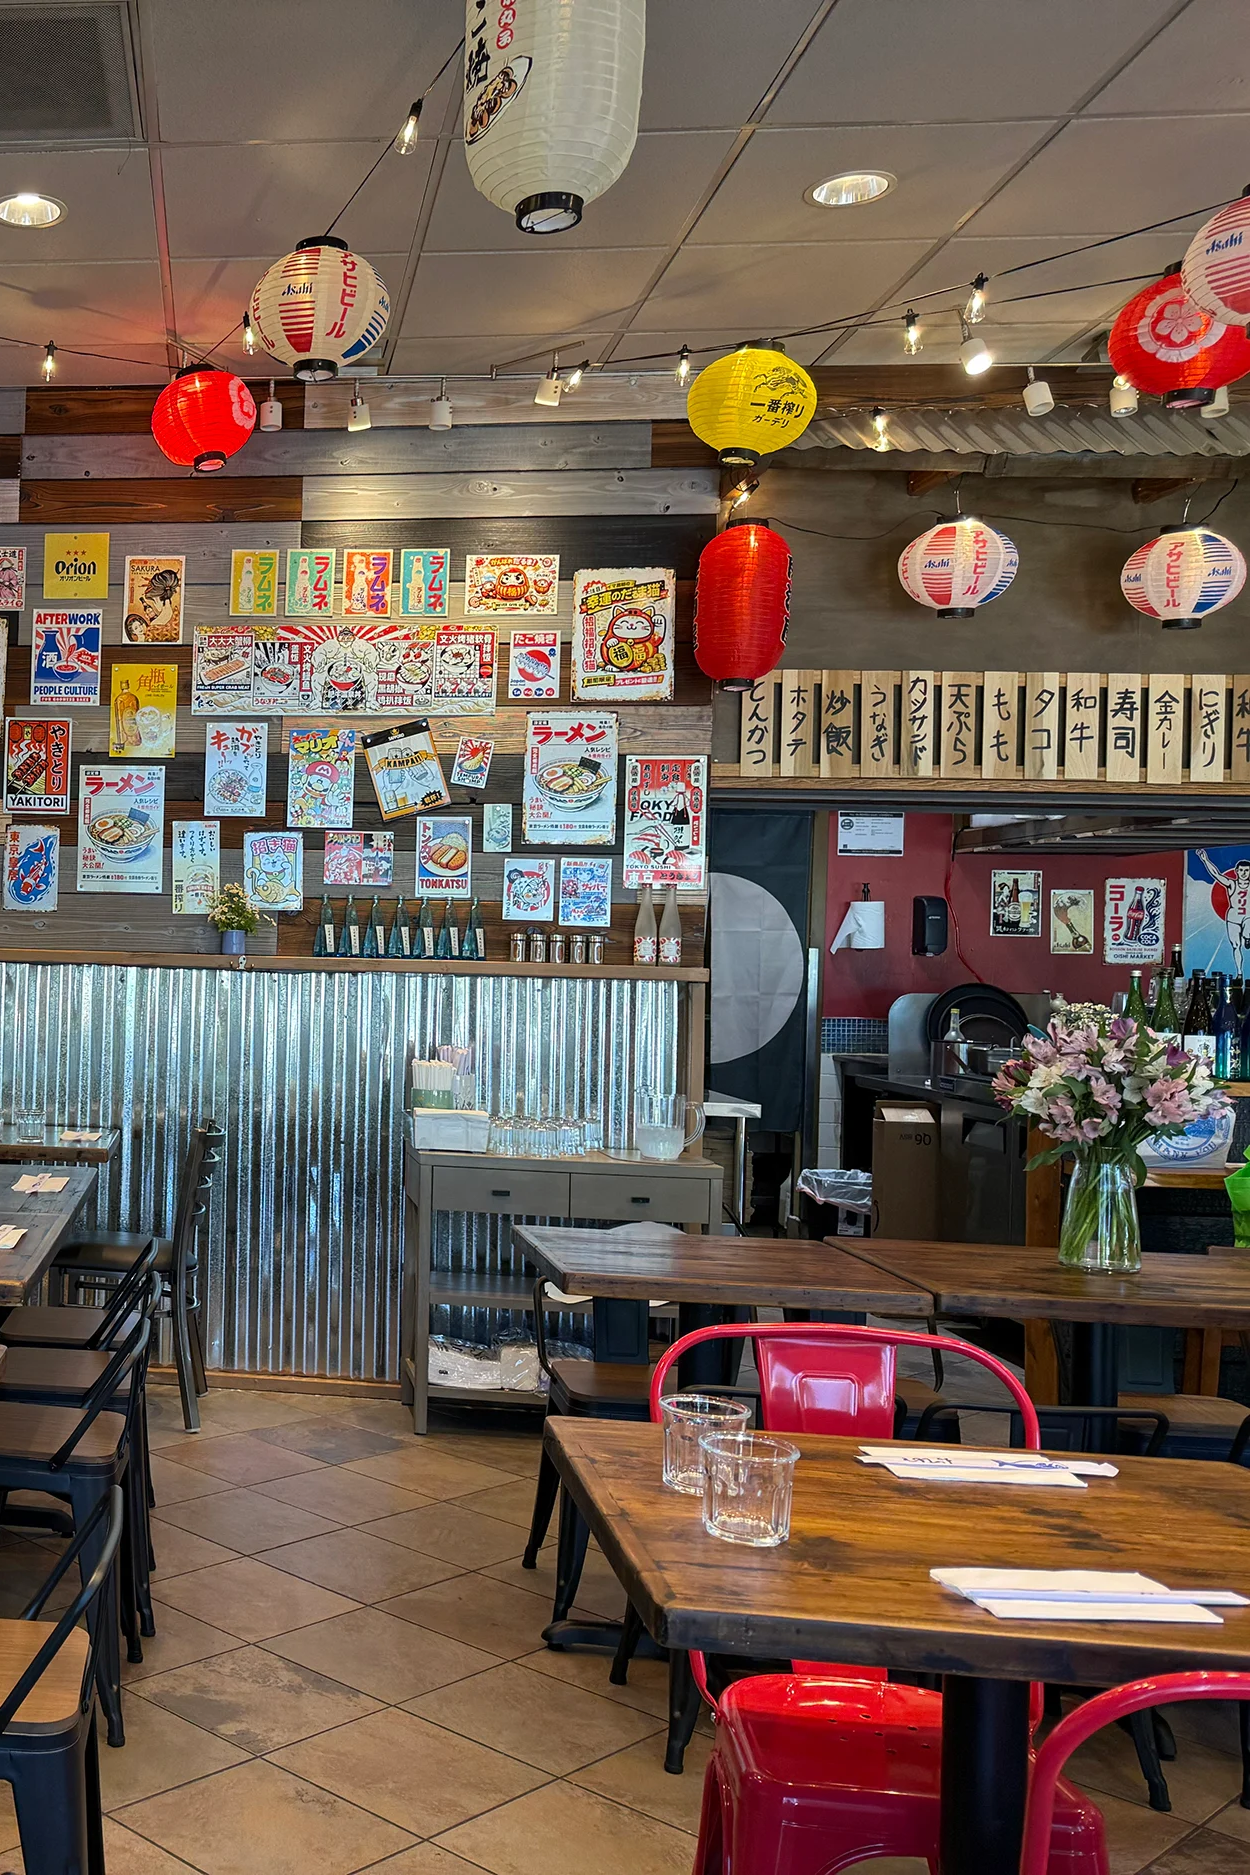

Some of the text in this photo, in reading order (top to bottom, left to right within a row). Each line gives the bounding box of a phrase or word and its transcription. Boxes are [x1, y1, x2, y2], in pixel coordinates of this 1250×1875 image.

[1206, 232, 1243, 255] Asahi
[282, 281, 313, 296] Asahi
[750, 398, 805, 418] 一番搾り
[55, 557, 97, 575] Orion
[924, 557, 950, 569] Asahi
[963, 530, 988, 596] アサヒビール
[1124, 573, 1142, 583] Asahi
[1164, 542, 1185, 608] アサヒビール
[1208, 566, 1232, 578] Asahi
[255, 556, 274, 612] ラムネ
[312, 555, 330, 611] ラムネ
[369, 556, 388, 612] ラムネ
[427, 555, 445, 612] ラムネ
[35, 613, 100, 625] AFTERWORK
[42, 652, 58, 668] 酒
[613, 645, 629, 661] 福
[34, 685, 97, 695] PEOPLE CULTURE
[532, 722, 608, 746] ラーメン
[746, 681, 769, 765] とんかつ
[786, 686, 808, 757] ホタテ
[822, 689, 852, 757] 炒飯
[870, 684, 888, 762] うなぎ
[946, 684, 972, 765] 天ぷら
[989, 687, 1012, 762] もも
[1031, 688, 1055, 750] タコ
[1069, 688, 1098, 753] 和牛
[1110, 688, 1139, 759] 寿司
[1153, 690, 1180, 769] 金カレー
[1198, 688, 1220, 768] にぎり
[50, 726, 66, 792] やきとり
[294, 735, 339, 754] マリオ
[85, 773, 156, 797] ラーメン
[9, 796, 65, 808] YAKITORI
[252, 838, 298, 855] 招き猫
[175, 879, 183, 912] 一番搾り
[419, 878, 468, 889] TONKATSU
[1236, 890, 1247, 916] グリコ
